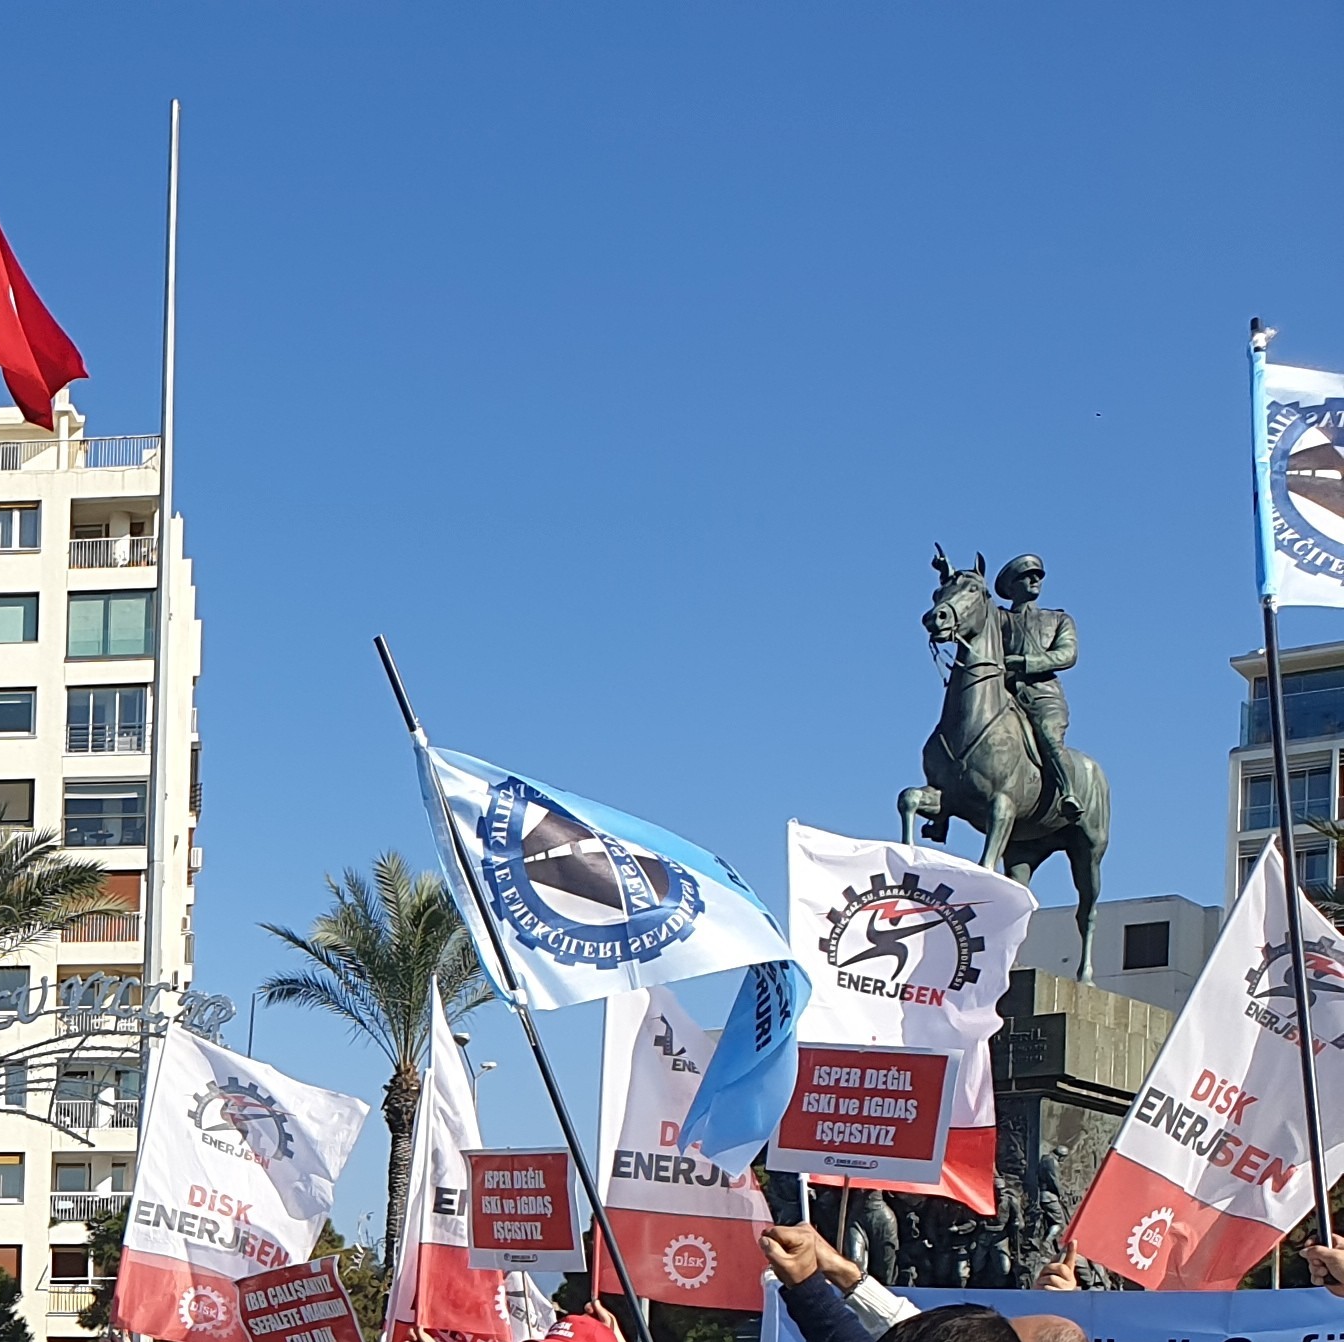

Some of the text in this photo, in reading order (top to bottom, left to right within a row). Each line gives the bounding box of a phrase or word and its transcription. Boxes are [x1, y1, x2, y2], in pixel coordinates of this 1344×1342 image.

[671, 1058, 701, 1075] ENE
[839, 1099, 860, 1115] ve
[502, 1200, 515, 1214] ve
[248, 1309, 302, 1336] SEFALETE
